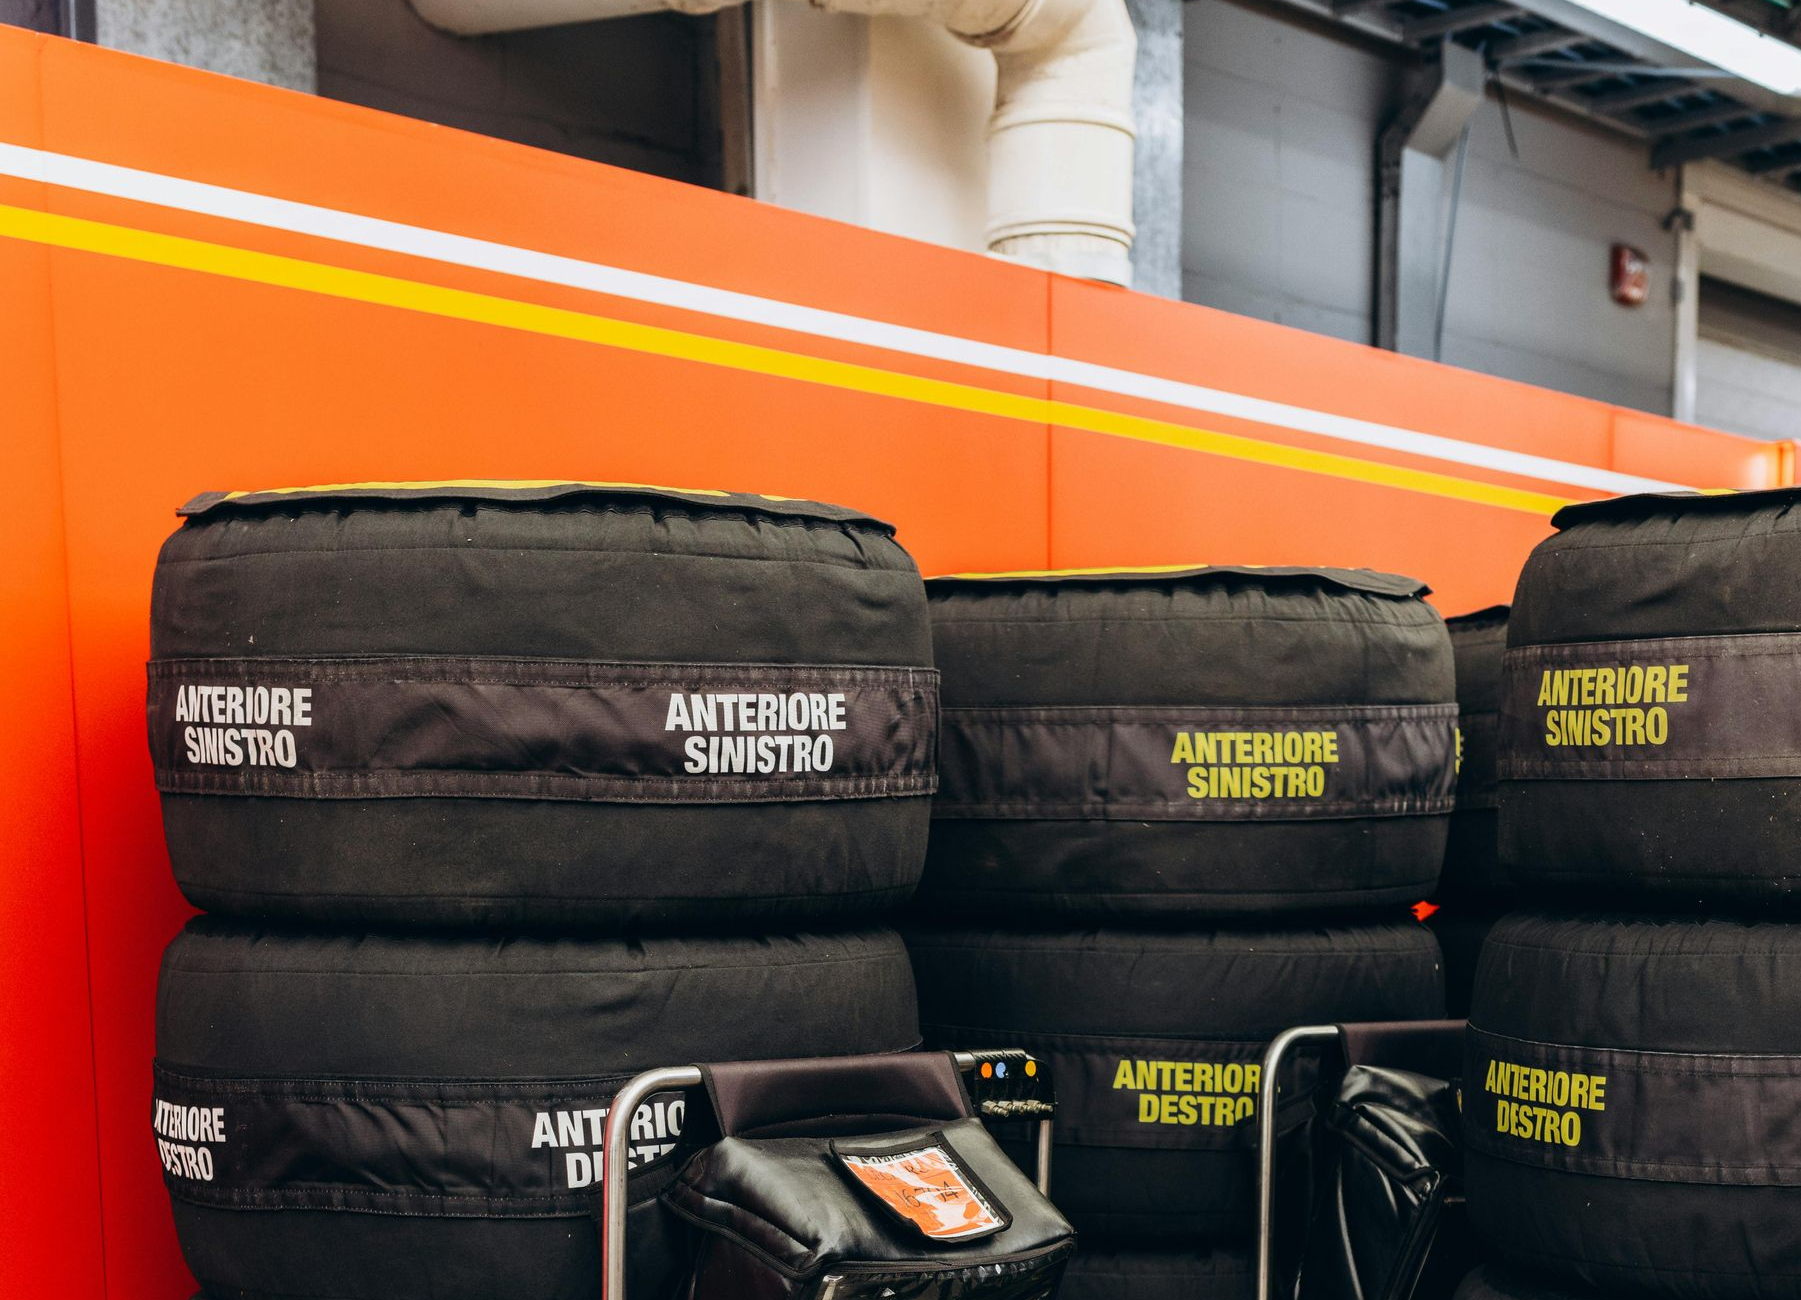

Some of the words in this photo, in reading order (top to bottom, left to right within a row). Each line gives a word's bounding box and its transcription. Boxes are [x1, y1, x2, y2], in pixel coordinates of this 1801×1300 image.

[1537, 664, 1689, 706] ANTERIORE
[176, 685, 312, 726] ANTERIORE
[665, 692, 847, 731] ANTERIORE
[1545, 706, 1668, 746] SINISTRO
[184, 726, 297, 768] SINISTRO
[684, 734, 834, 774] SINISTRO
[1170, 731, 1339, 764] ANTERIORE
[1187, 766, 1325, 798] SINISTRO
[1112, 1060, 1281, 1094] ANTERIOR
[1485, 1059, 1606, 1111] ANTERIORE
[531, 1100, 685, 1149] ANTRIO
[1497, 1099, 1581, 1147] DESTRO
